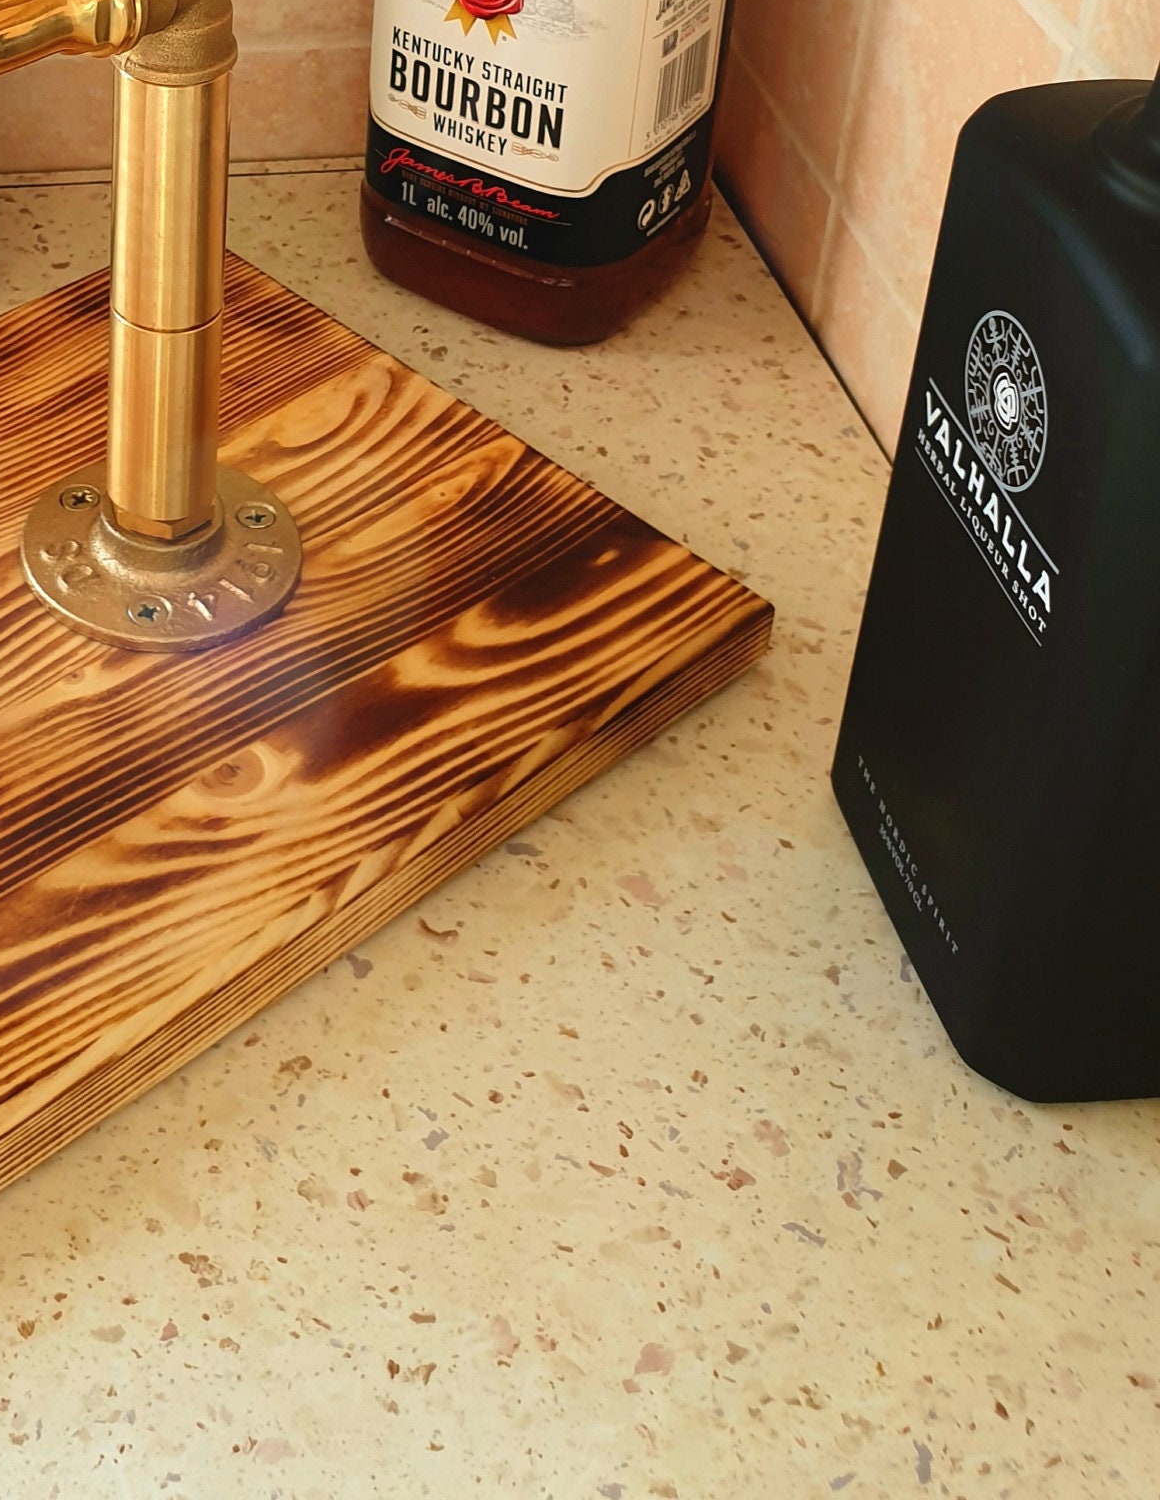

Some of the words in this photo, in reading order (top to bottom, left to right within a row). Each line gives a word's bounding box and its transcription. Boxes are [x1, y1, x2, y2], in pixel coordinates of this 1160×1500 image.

[390, 48, 564, 151] BOURBON
[392, 26, 475, 74] KENTUCKY
[482, 61, 568, 104] STRAIGHT
[433, 112, 508, 156] WHISKEY
[380, 147, 459, 186] James
[486, 185, 560, 219] Beam
[401, 181, 418, 206] 1L
[427, 195, 453, 221] alc.
[457, 205, 494, 237] 40%
[499, 225, 529, 250] vol.
[917, 428, 958, 497] HERBAL
[959, 496, 1010, 580] LIQUEUR
[1011, 580, 1047, 633] SHOT
[926, 391, 1051, 613] VALHALLA
[878, 799, 918, 877] NORDIC
